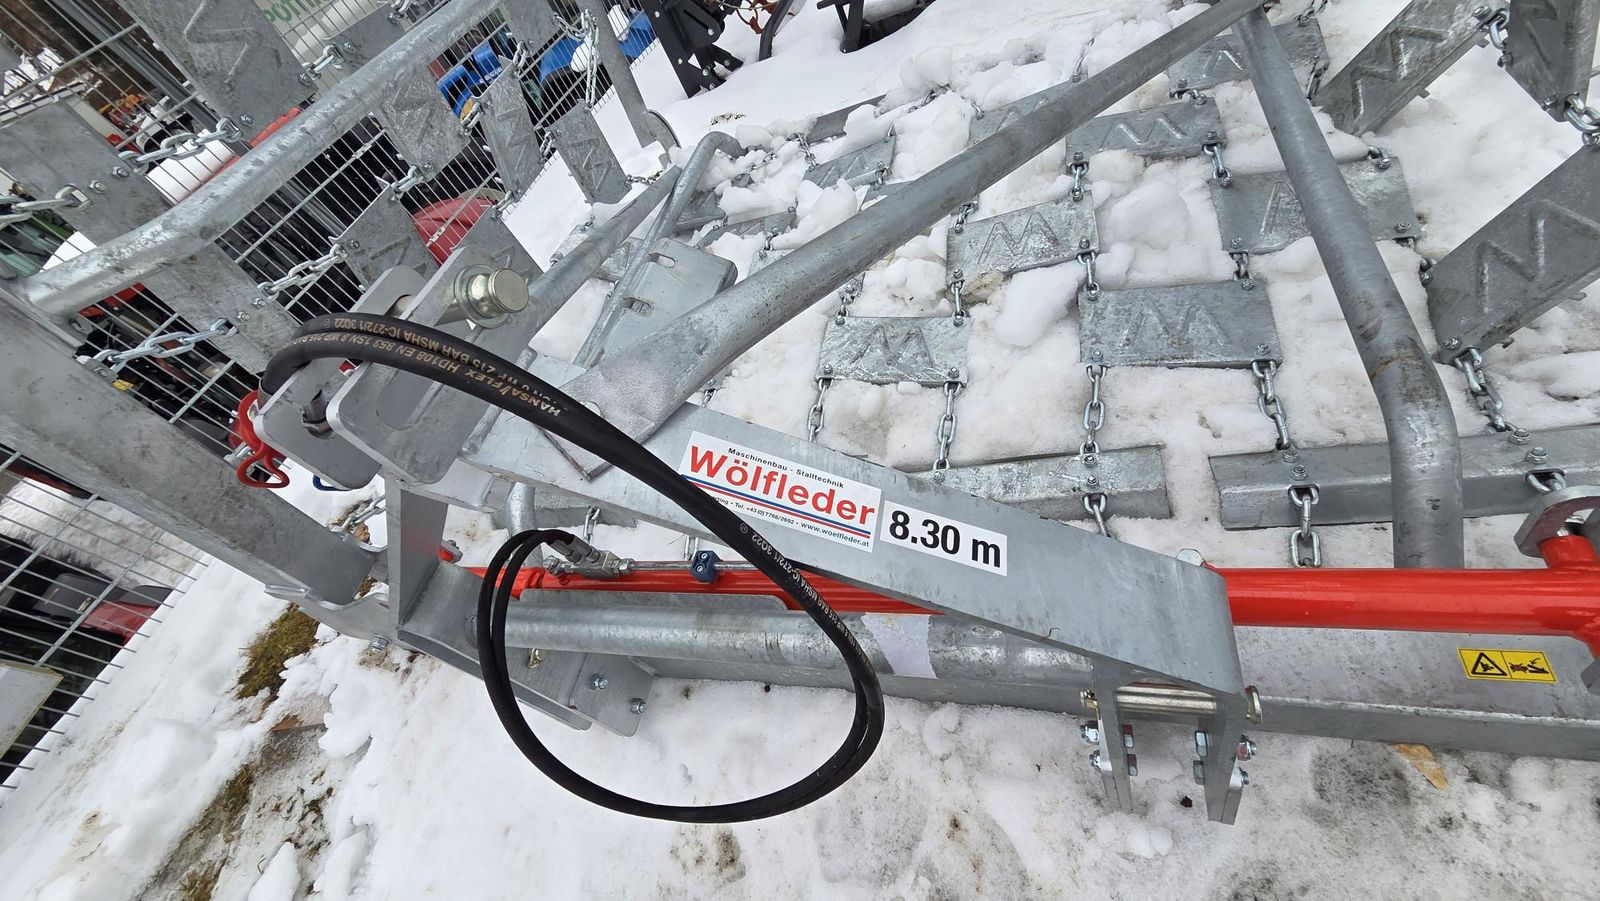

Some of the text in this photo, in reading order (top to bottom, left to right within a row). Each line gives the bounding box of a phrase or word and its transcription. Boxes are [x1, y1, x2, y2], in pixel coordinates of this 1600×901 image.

[395, 344, 417, 358] EN
[403, 330, 440, 352] MSHA
[416, 351, 460, 373] HD108
[442, 344, 470, 364] BAR
[472, 359, 496, 373] 215
[728, 447, 788, 471] Maschinenbau
[796, 468, 845, 489] Stalltechnik
[690, 445, 875, 525] Wölfleder
[735, 501, 745, 510] Tel.
[800, 522, 870, 548] www.woelfleder.at
[889, 510, 1001, 568] 8.30 m
